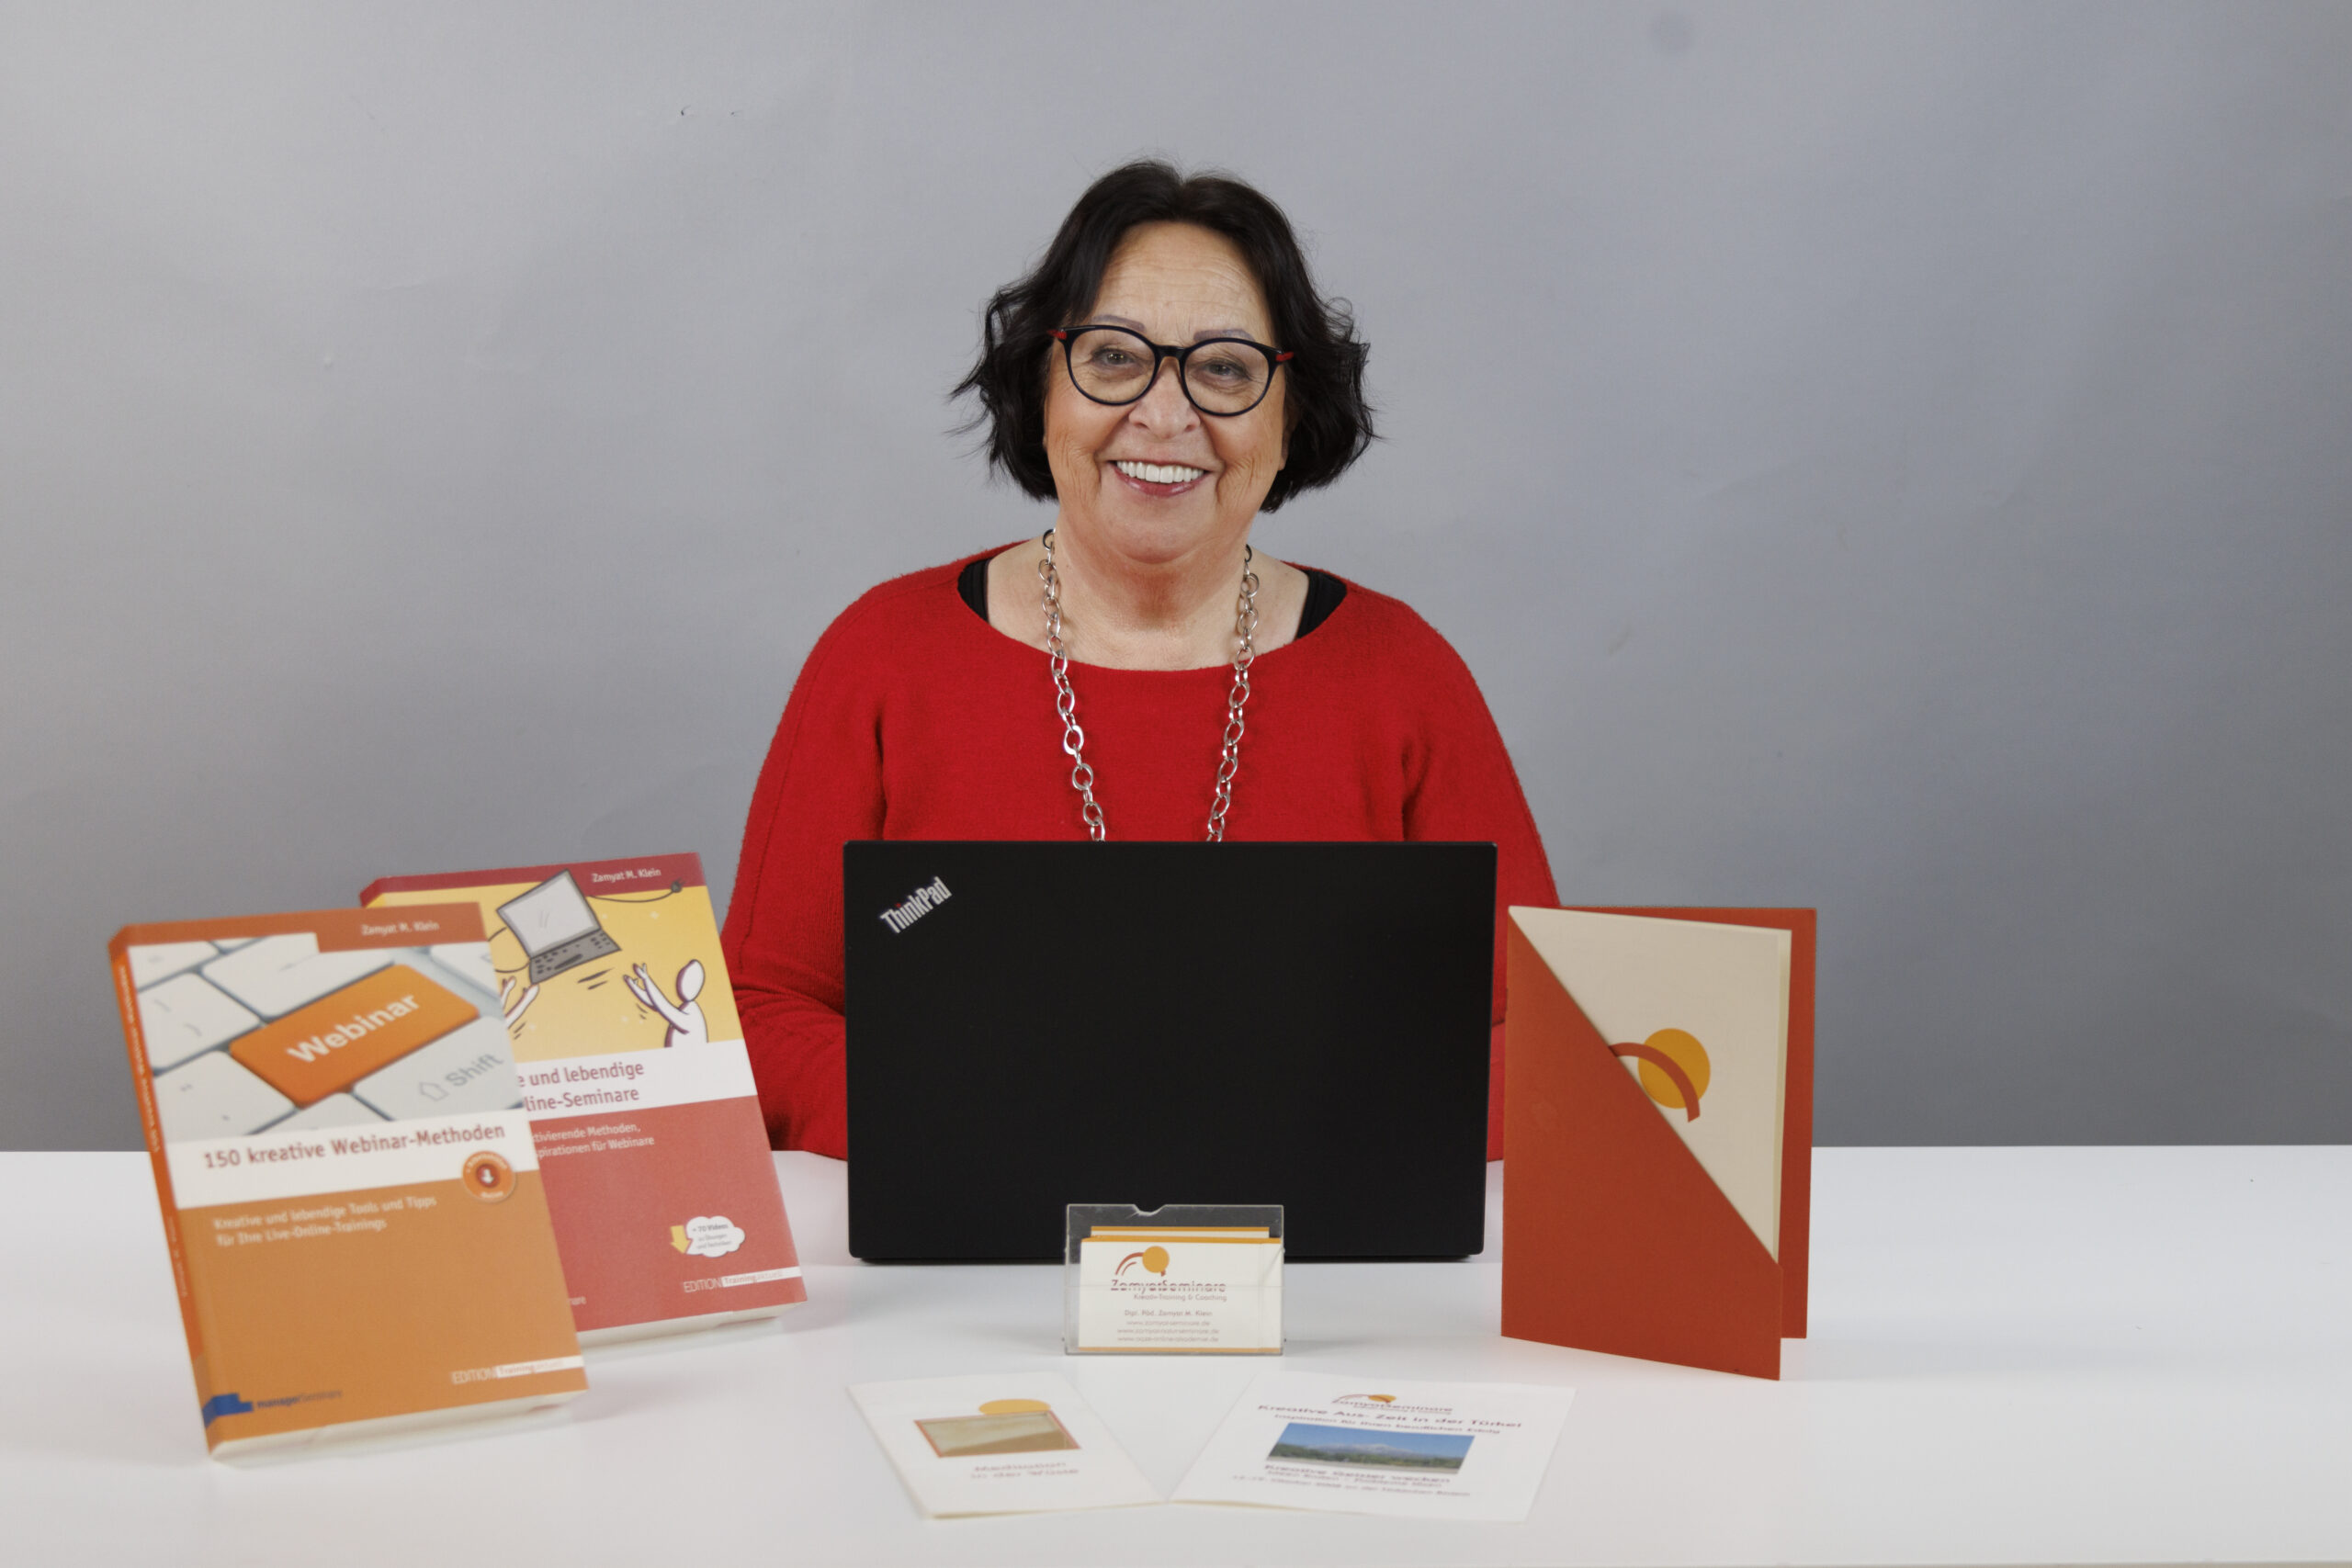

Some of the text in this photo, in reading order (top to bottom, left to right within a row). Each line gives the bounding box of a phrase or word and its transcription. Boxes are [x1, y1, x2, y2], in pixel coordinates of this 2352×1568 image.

[592, 871, 627, 884] Zamyat
[639, 867, 662, 878] Klein
[879, 876, 953, 933] ThinkPad
[361, 922, 397, 936] Zamyat
[414, 920, 439, 931] Klein
[286, 994, 420, 1063] Webinar
[445, 1054, 504, 1088] Shift
[529, 1068, 560, 1087] und
[563, 1062, 645, 1082] lebendige
[525, 1089, 640, 1111] line-Seminare
[587, 1123, 641, 1137] Methoden,
[204, 1123, 505, 1168] 150 kreative Webinar-Methoden
[592, 1140, 607, 1152] für
[607, 1136, 655, 1149] Webinare
[213, 1194, 438, 1231] Kreative und lebendige Tools und Tipps
[217, 1217, 388, 1247] für Ihre Live-Online-Trainings
[683, 1277, 723, 1293] EDITION
[1194, 1293, 1227, 1303] Coaching
[451, 1366, 497, 1384] EDITION
[1258, 1404, 1328, 1415] Kreative
